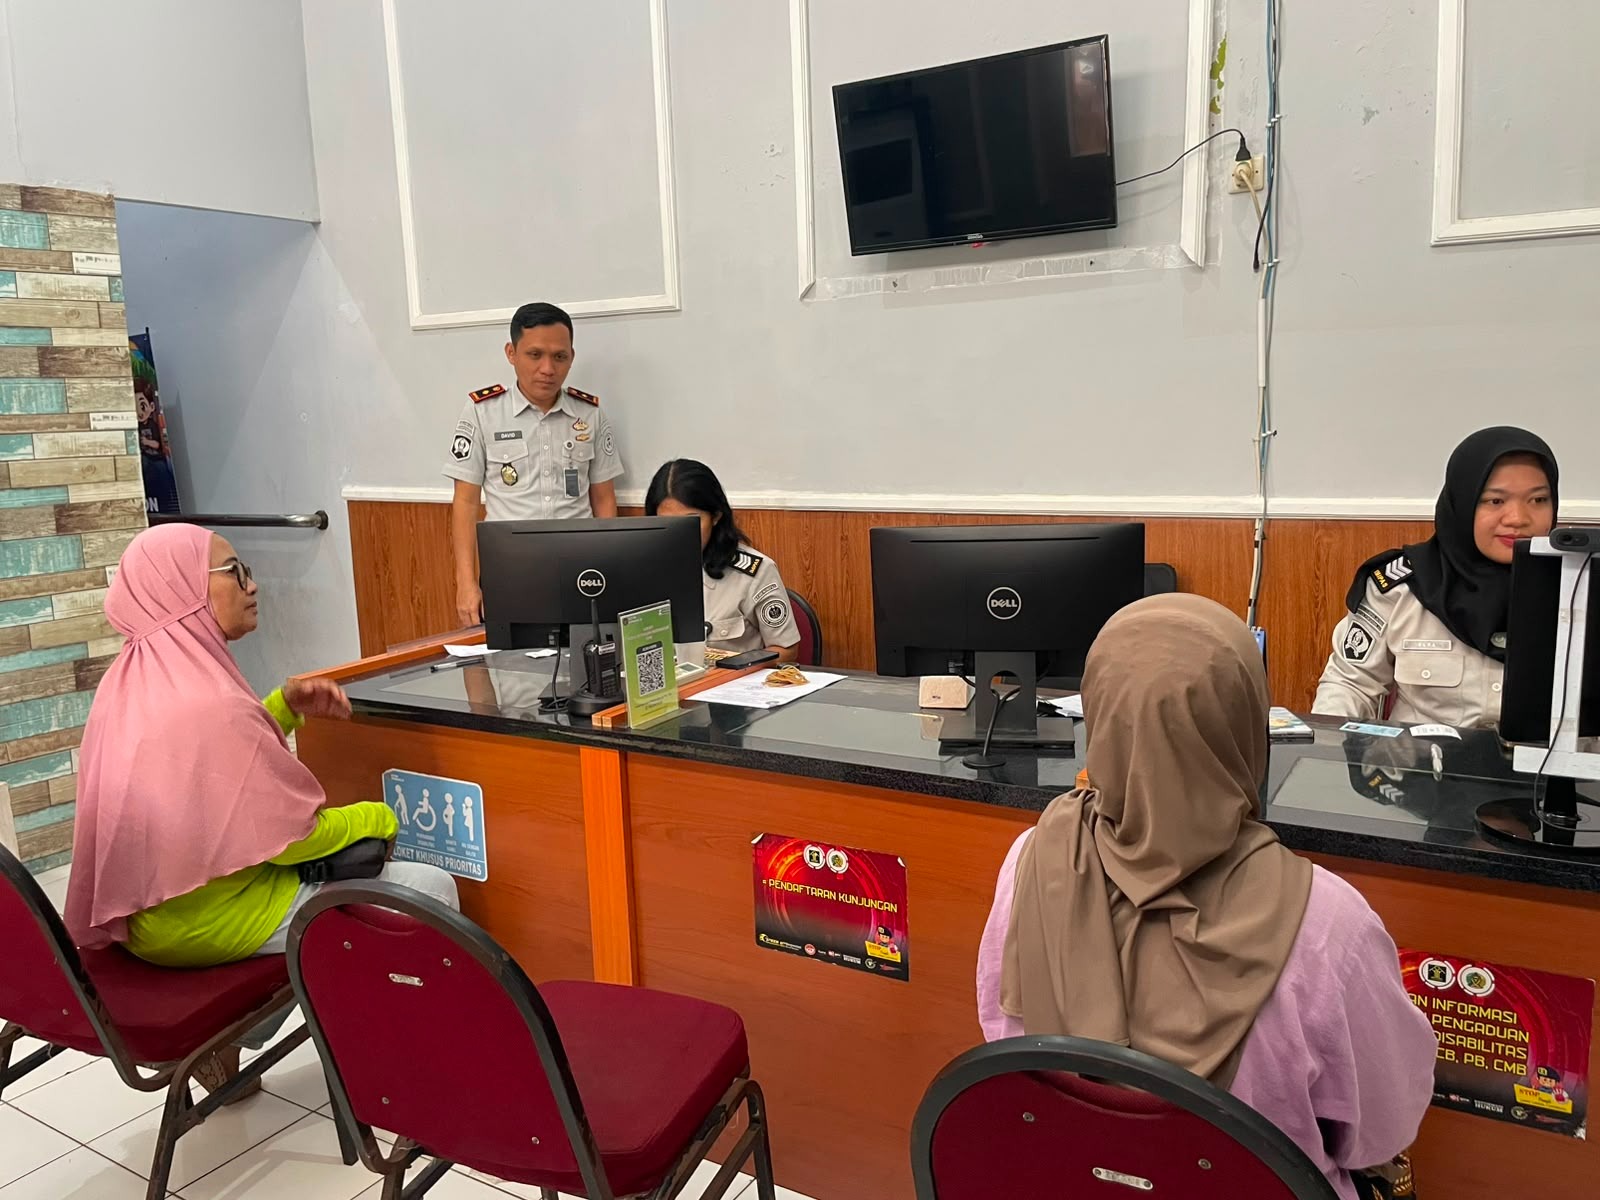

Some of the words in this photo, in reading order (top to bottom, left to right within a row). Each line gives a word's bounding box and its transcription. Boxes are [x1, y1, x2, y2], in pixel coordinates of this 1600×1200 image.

[580, 579, 603, 587] DELL
[990, 599, 1018, 608] DELL
[393, 845, 414, 860] LOKET
[415, 849, 444, 867] KHUSUS
[445, 855, 482, 876] PRIORITAS
[768, 878, 837, 901] PENDAFTARAN
[838, 892, 898, 913] KUNJUNGAN
[1432, 997, 1518, 1025] INFORMASI
[1431, 1013, 1530, 1043] PENGADUAN
[1493, 1058, 1528, 1076] CMB
